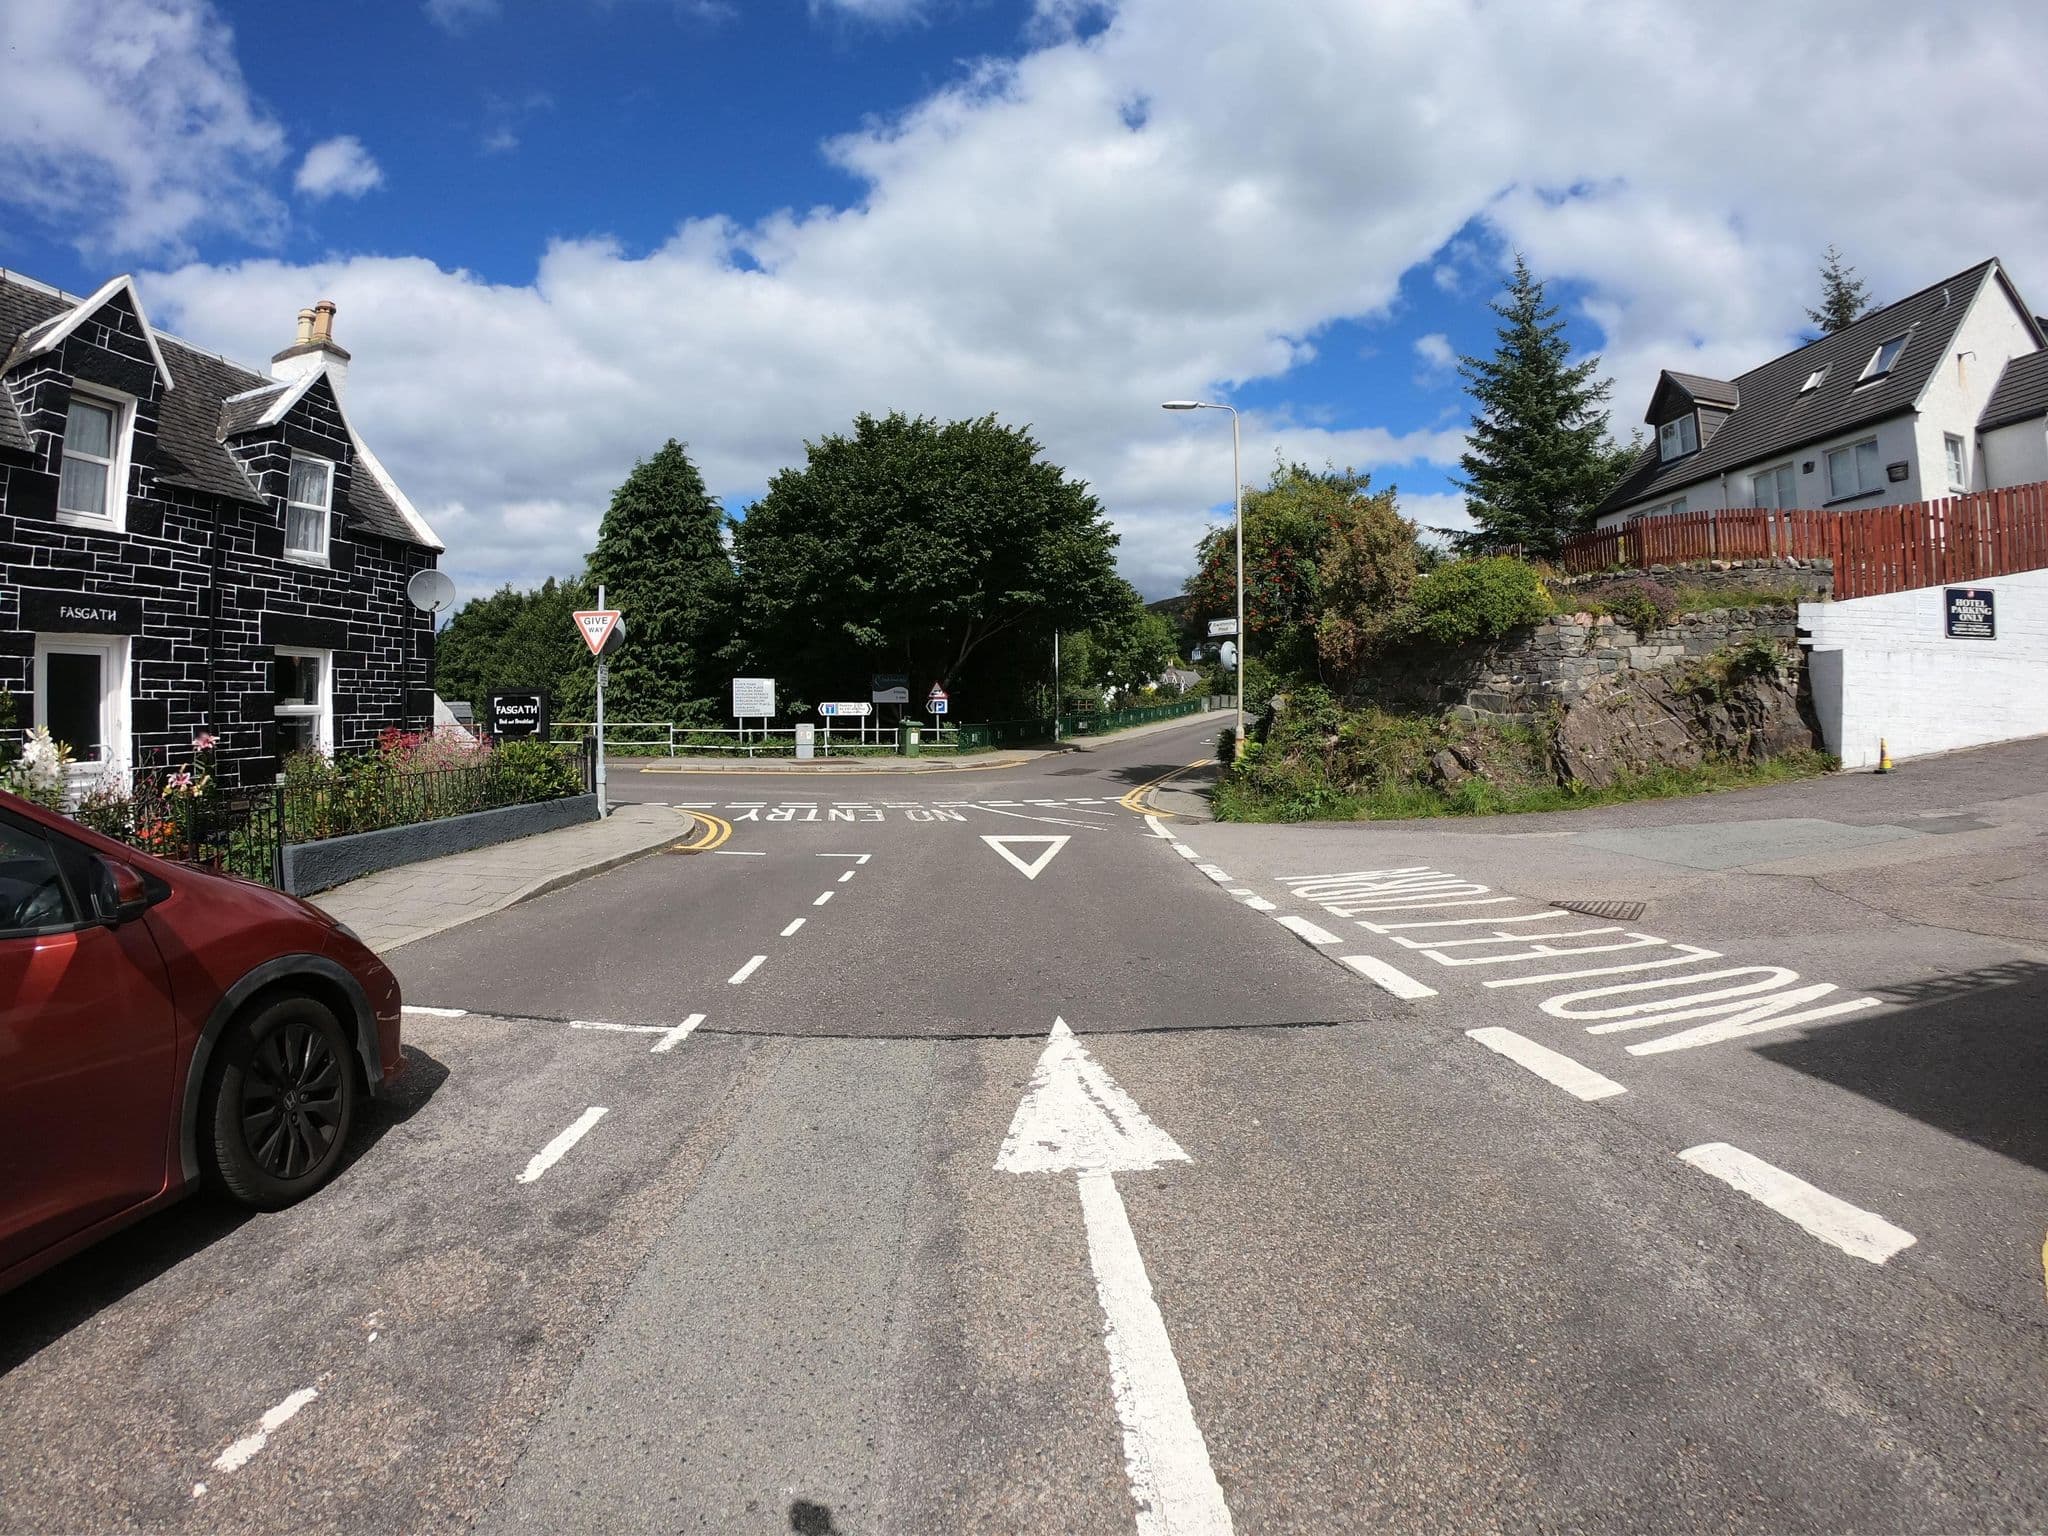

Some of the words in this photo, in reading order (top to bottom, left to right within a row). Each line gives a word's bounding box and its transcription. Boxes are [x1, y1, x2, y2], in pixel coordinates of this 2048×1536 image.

[1951, 605, 1992, 615] PARKING
[1955, 599, 1987, 608] HOTEL
[60, 606, 117, 621] FASGATH
[1959, 614, 1984, 622] ONLY
[583, 617, 608, 625] GIVE
[496, 705, 537, 715] FASGATH
[733, 808, 886, 822] ENTRY
[904, 808, 968, 822] NO
[1275, 866, 1518, 917] TURN
[1355, 910, 1724, 989] LEFT
[1539, 966, 1883, 1057] NO
